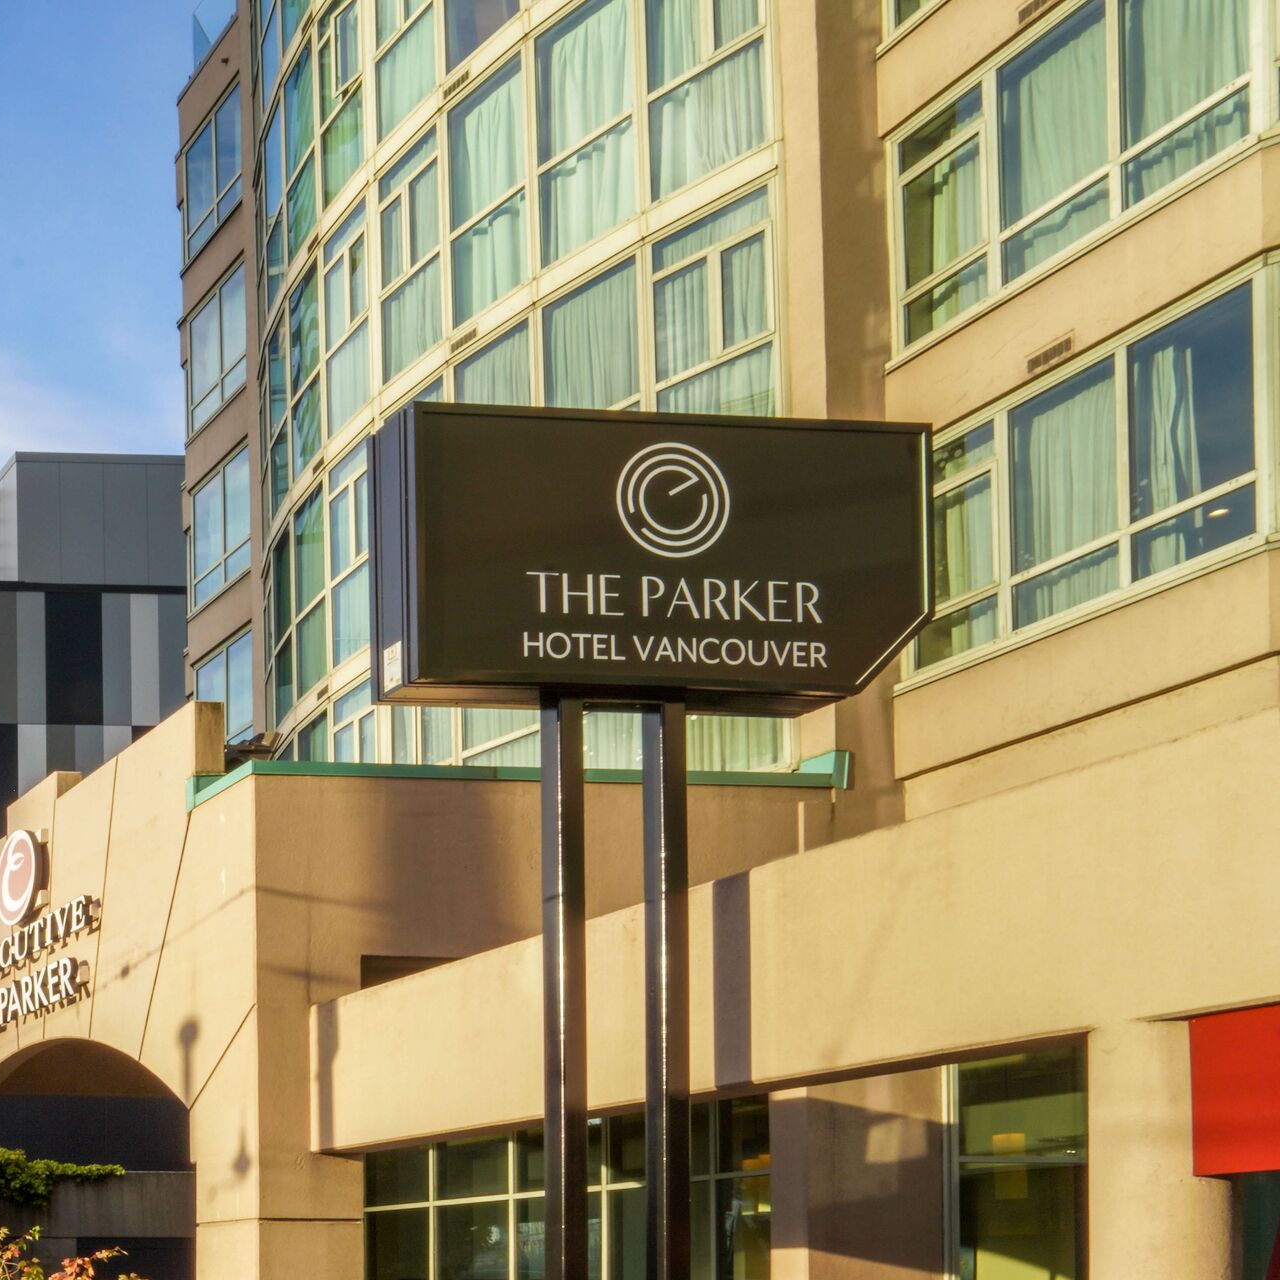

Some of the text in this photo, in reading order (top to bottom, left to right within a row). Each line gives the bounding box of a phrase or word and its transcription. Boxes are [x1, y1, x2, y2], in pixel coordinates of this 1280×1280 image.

[526, 571, 823, 624] THE PARKER
[522, 631, 828, 669] HOTEL VANCOUVER
